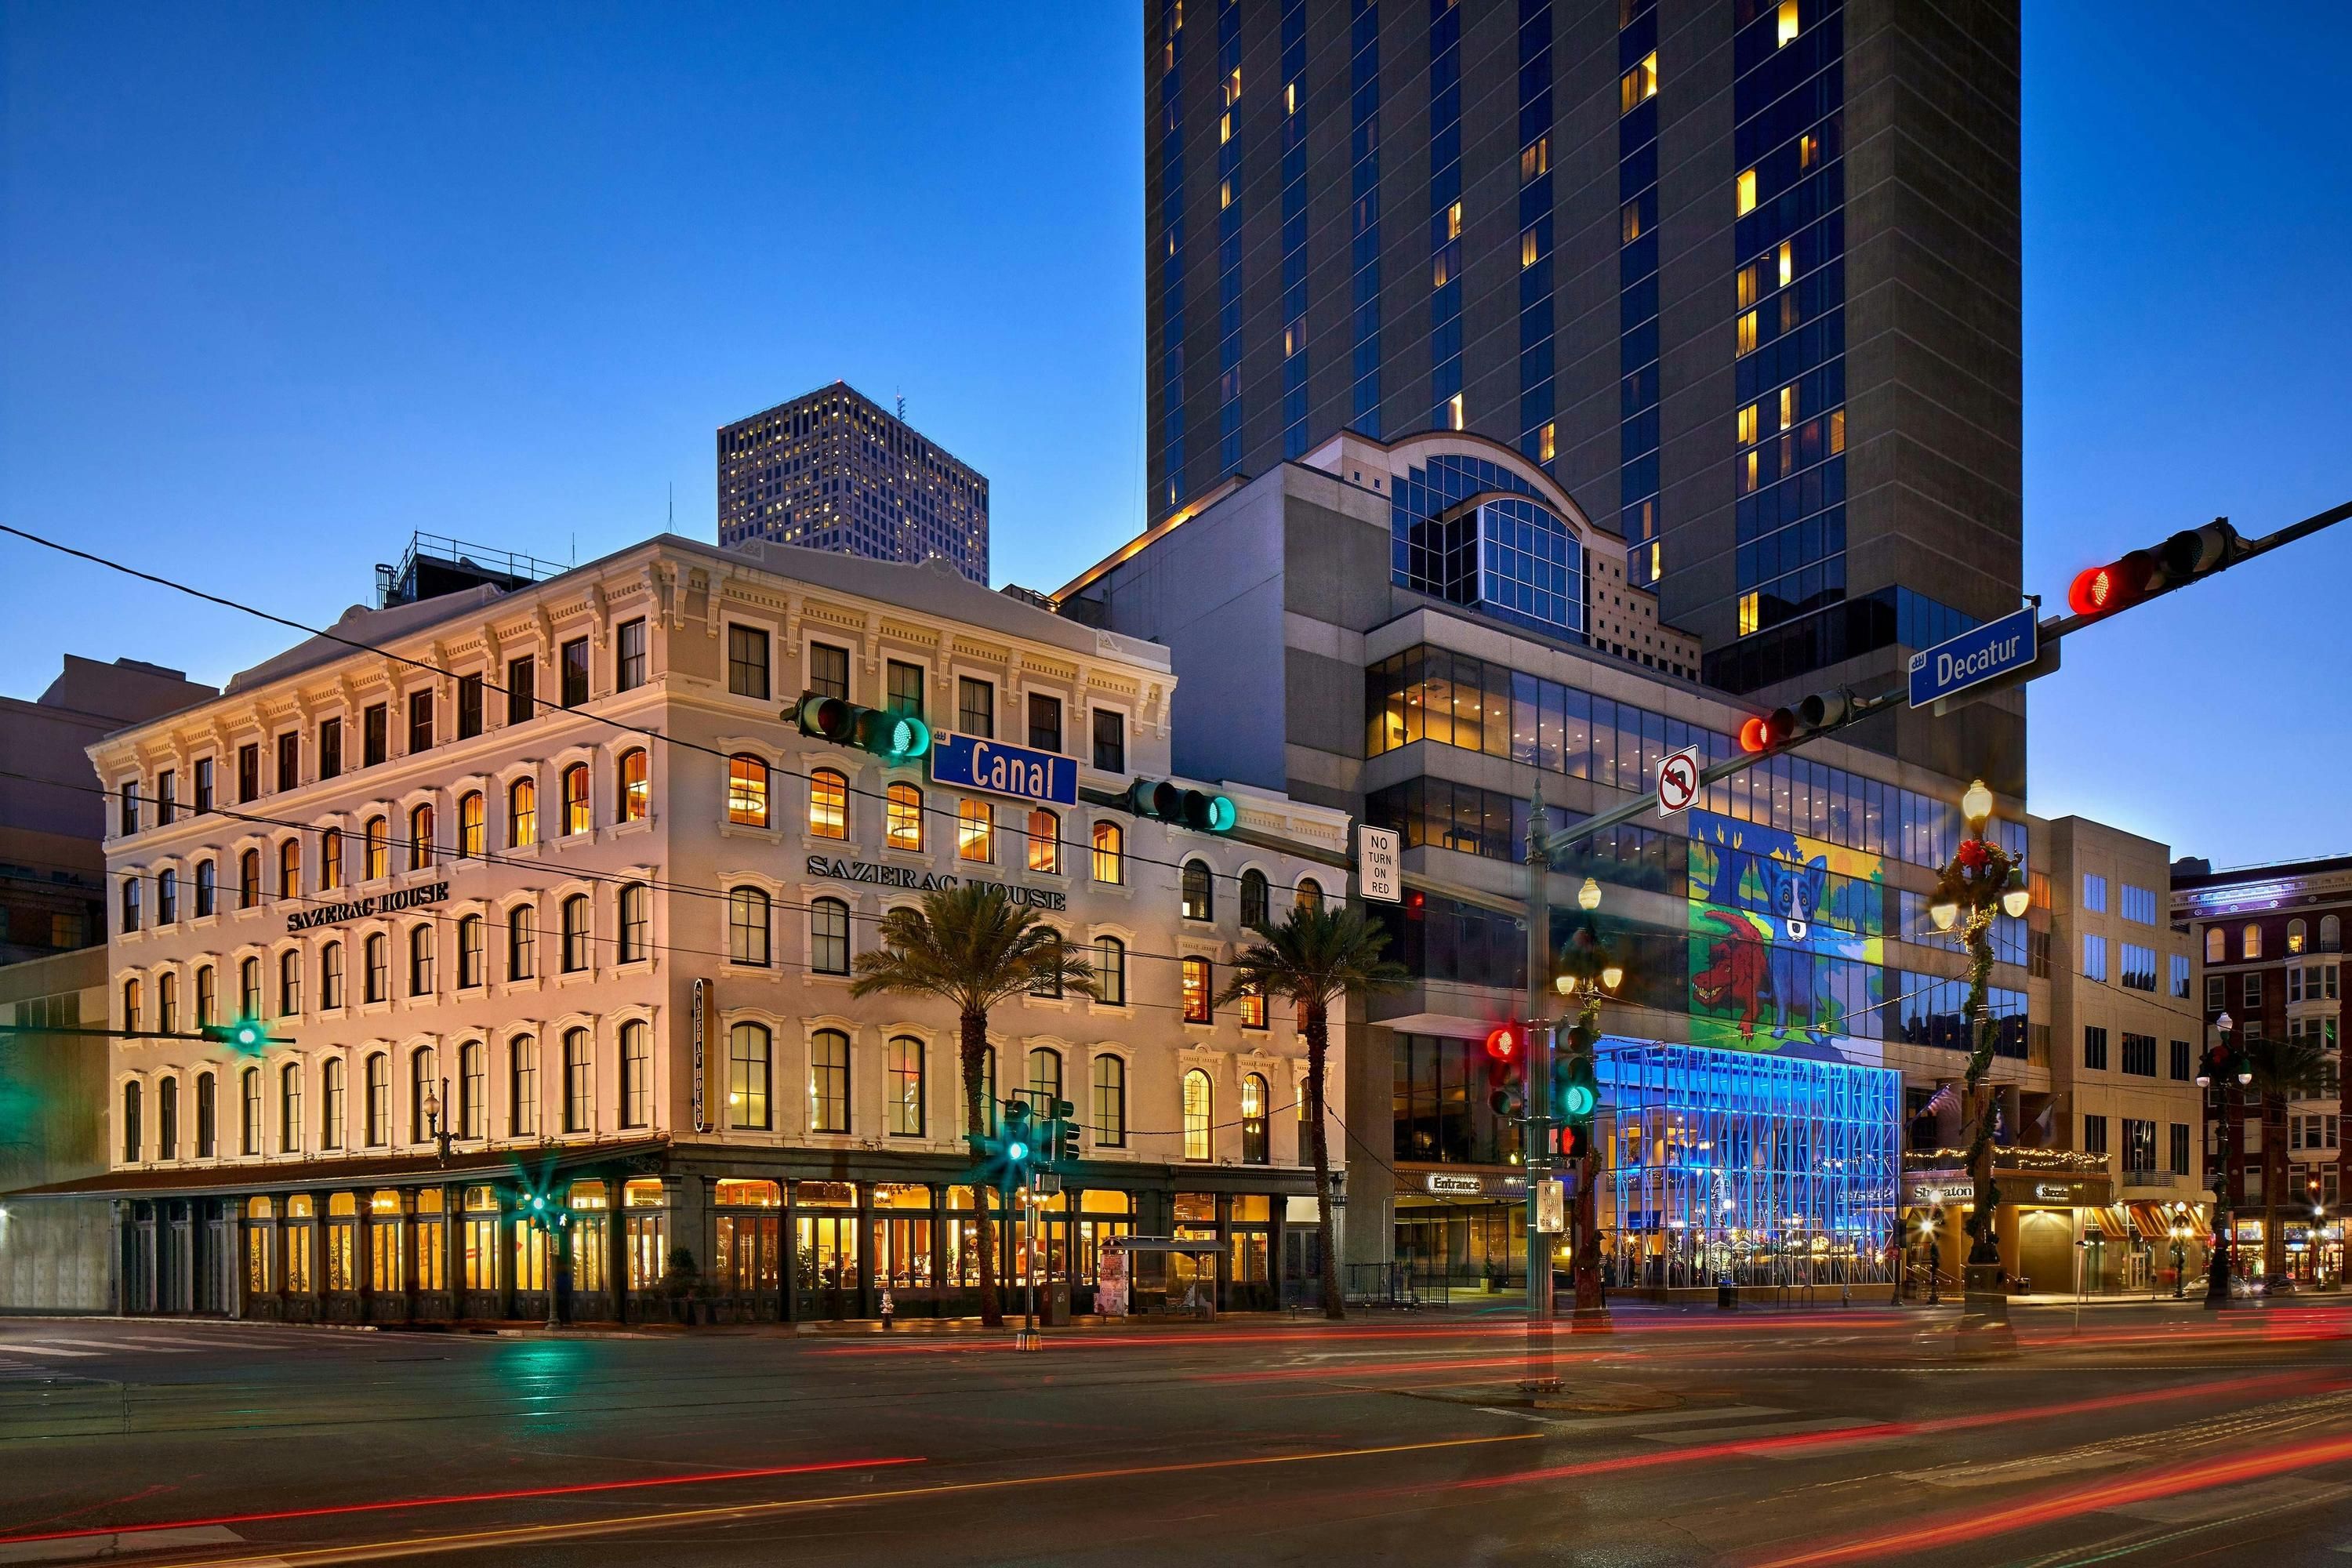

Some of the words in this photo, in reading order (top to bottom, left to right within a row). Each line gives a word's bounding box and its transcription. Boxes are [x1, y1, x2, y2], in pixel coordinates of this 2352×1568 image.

[1937, 635, 2020, 688] Decatur
[972, 742, 1054, 799] Canal
[1371, 835, 1388, 850] NO
[1368, 851, 1392, 866] TURN
[808, 855, 957, 892] SAZERAC
[1374, 867, 1386, 879] ON
[1372, 881, 1389, 895] RED
[287, 898, 375, 932] SAZERAC
[377, 881, 449, 914] HOUSE
[1434, 1177, 1481, 1190] Entrance
[1915, 1186, 1973, 1198] Shaton
